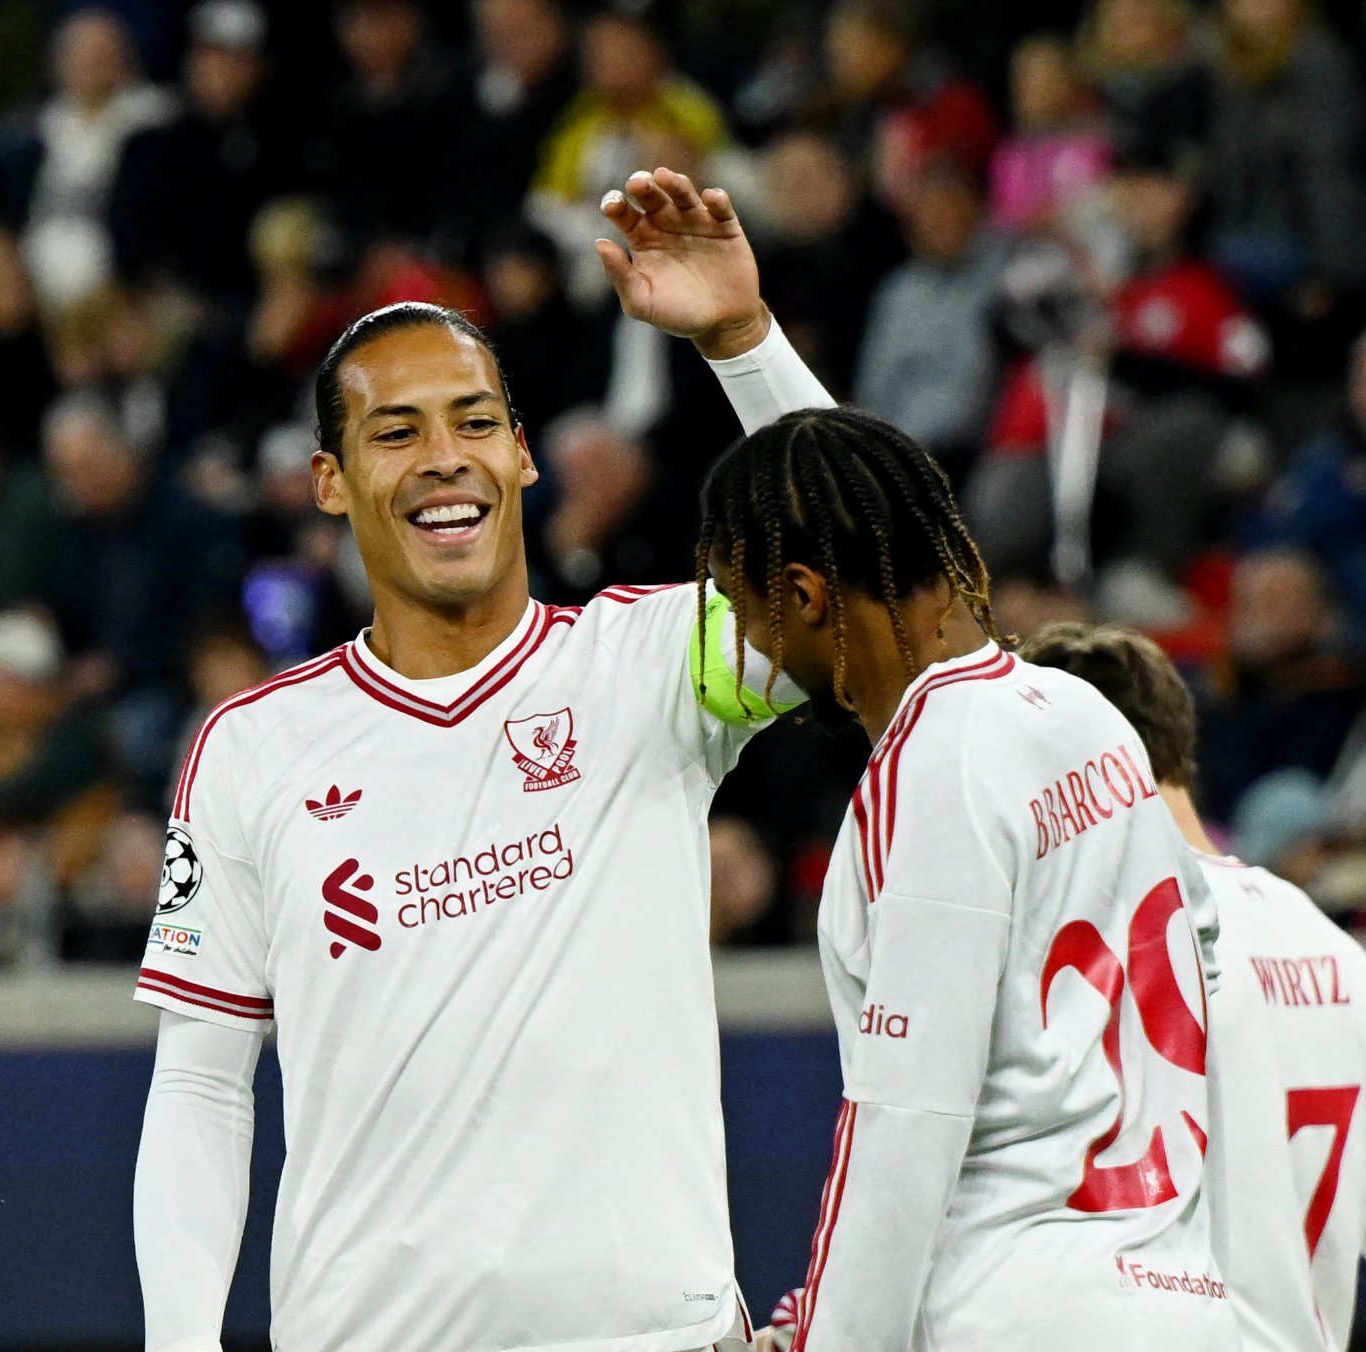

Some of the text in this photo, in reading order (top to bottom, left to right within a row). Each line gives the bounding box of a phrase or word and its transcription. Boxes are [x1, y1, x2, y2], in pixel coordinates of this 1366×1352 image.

[519, 759, 548, 779] LIVER
[525, 769, 579, 791] FOOTBALL CLUB
[551, 748, 574, 774] POOL
[1029, 744, 1159, 860] BBARCOL
[394, 823, 564, 895] standard
[397, 849, 574, 928] chartered
[1249, 955, 1351, 1006] WIRTZ
[1285, 1083, 1361, 1264] 7
